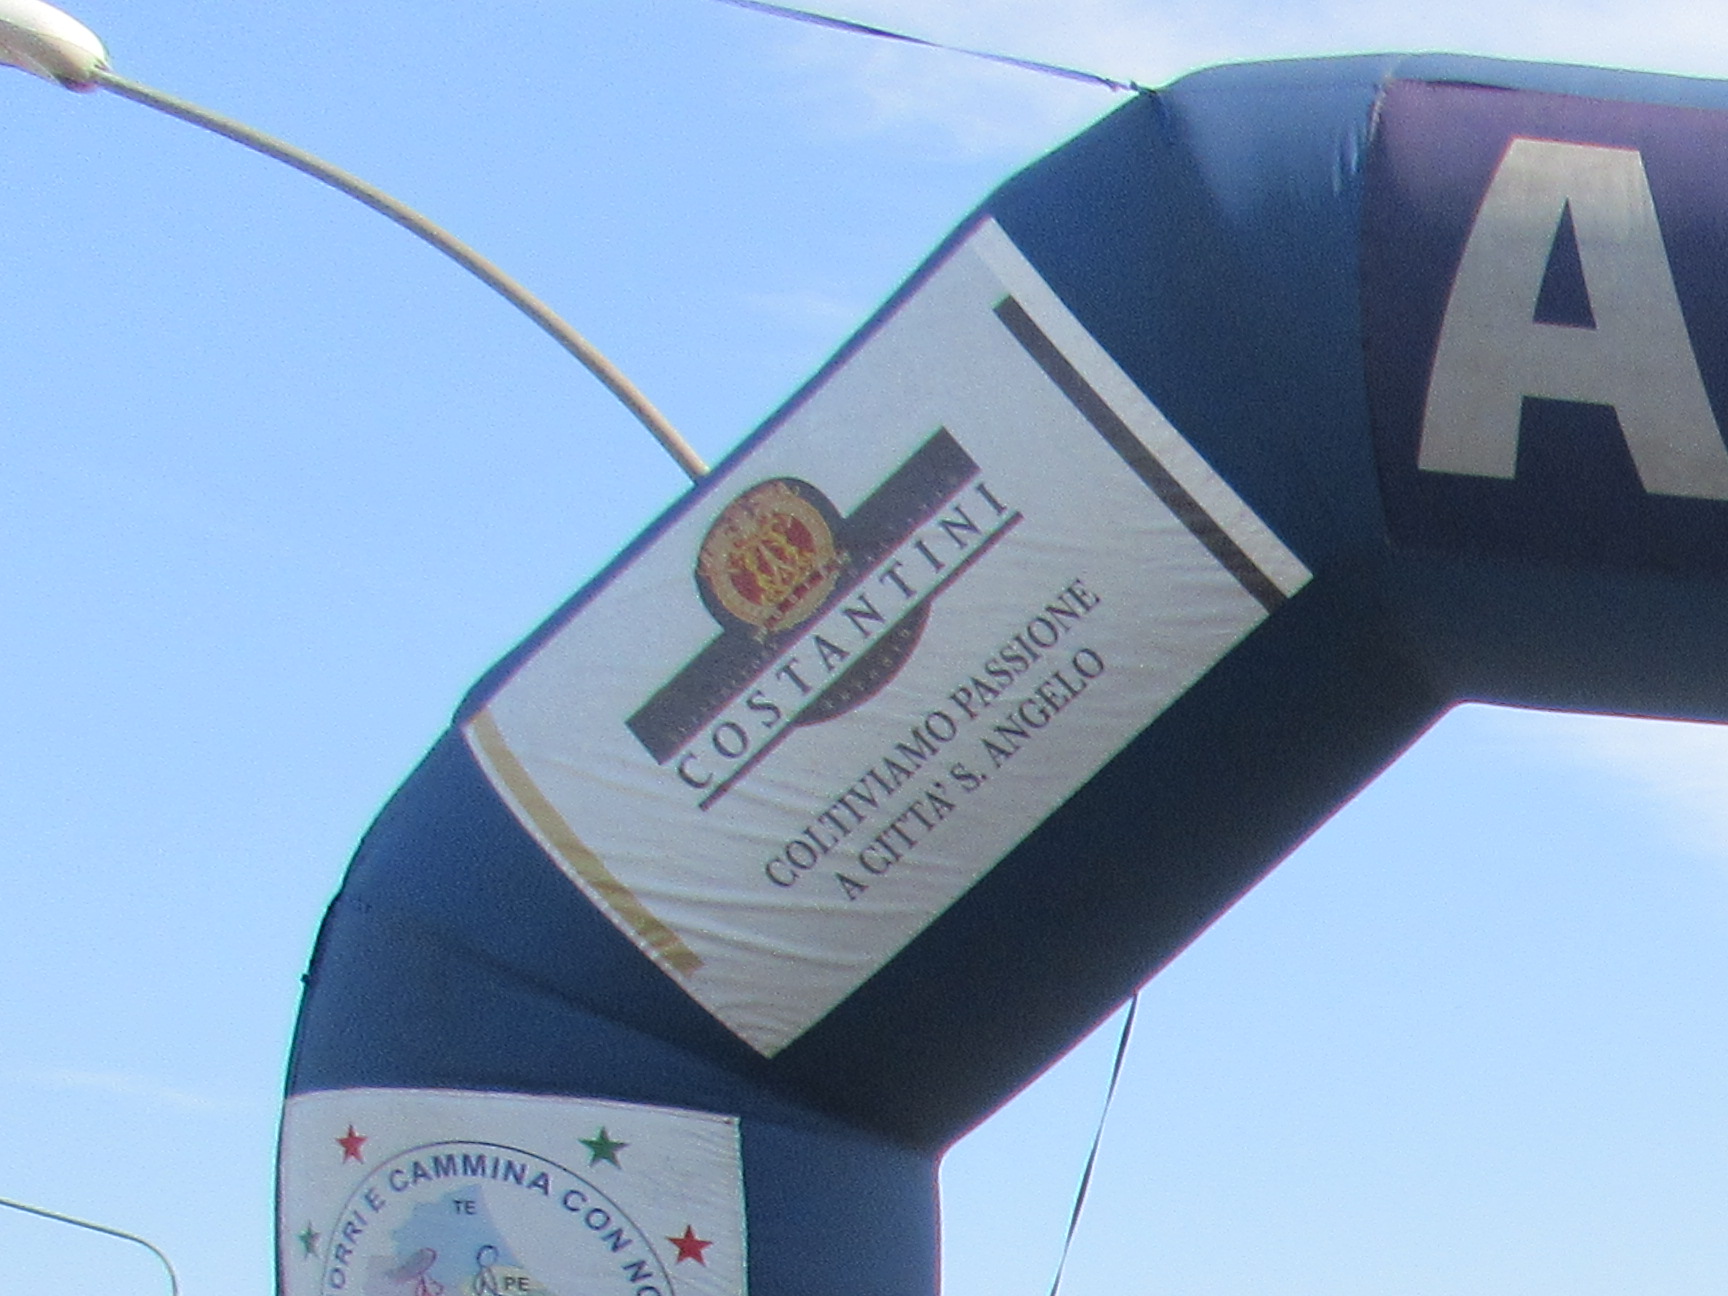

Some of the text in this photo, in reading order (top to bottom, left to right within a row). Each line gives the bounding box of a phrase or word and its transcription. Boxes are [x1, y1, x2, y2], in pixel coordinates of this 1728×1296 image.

[676, 482, 1008, 790] COSTANTINI
[764, 710, 958, 887] COLTIVIAMO
[950, 578, 1101, 720] PASSIONE
[834, 871, 869, 901] A
[859, 781, 957, 875] CITTA'
[950, 762, 988, 793] S.
[980, 647, 1105, 768] ANGELO
[389, 1153, 551, 1196] CAMMINA
[562, 1190, 633, 1253] CON
[453, 1200, 476, 1215] TE
[504, 1277, 530, 1292] PE
